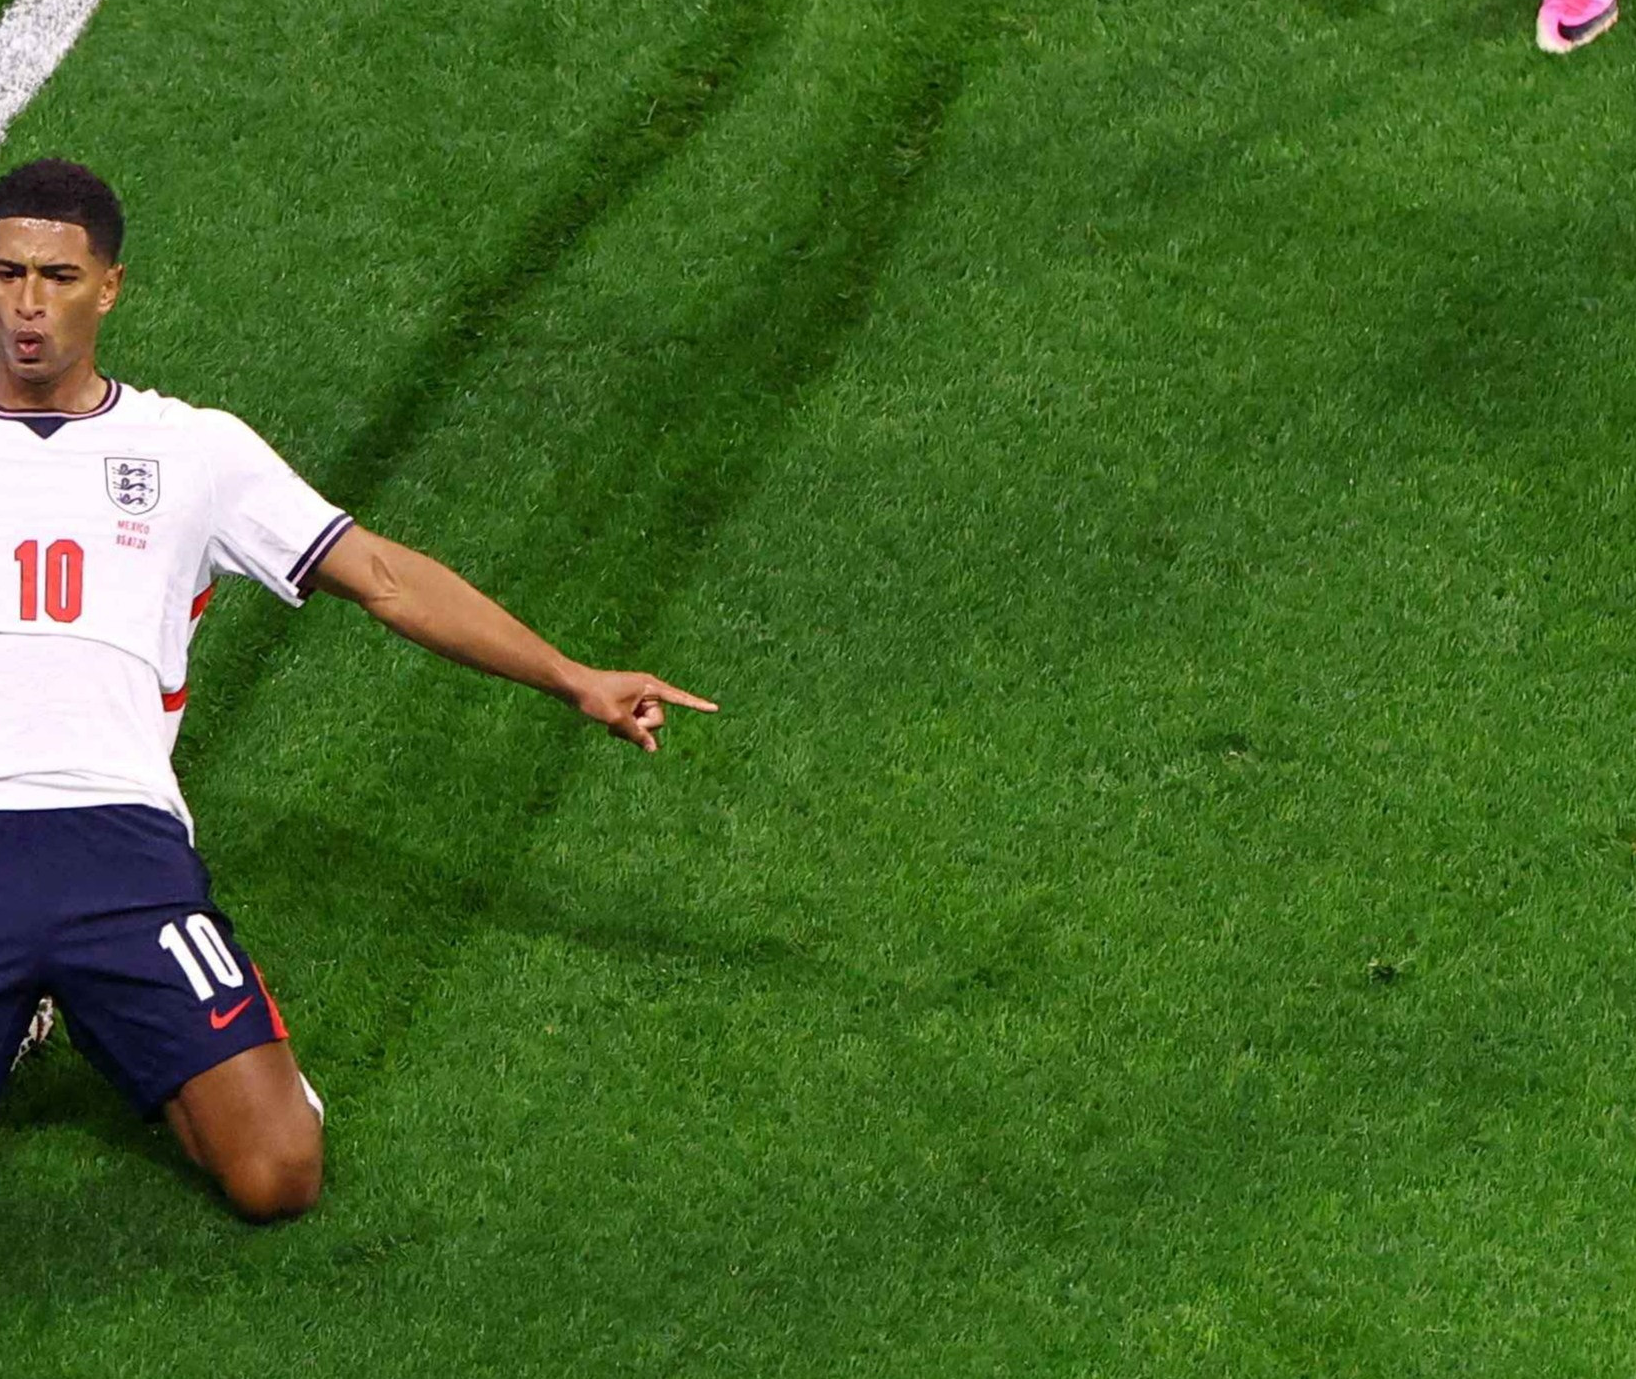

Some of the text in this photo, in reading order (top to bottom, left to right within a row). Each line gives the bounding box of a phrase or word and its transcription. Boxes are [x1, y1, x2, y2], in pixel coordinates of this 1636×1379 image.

[117, 520, 150, 535] MEXICO
[14, 538, 85, 623] 10
[158, 913, 244, 1002] 10
